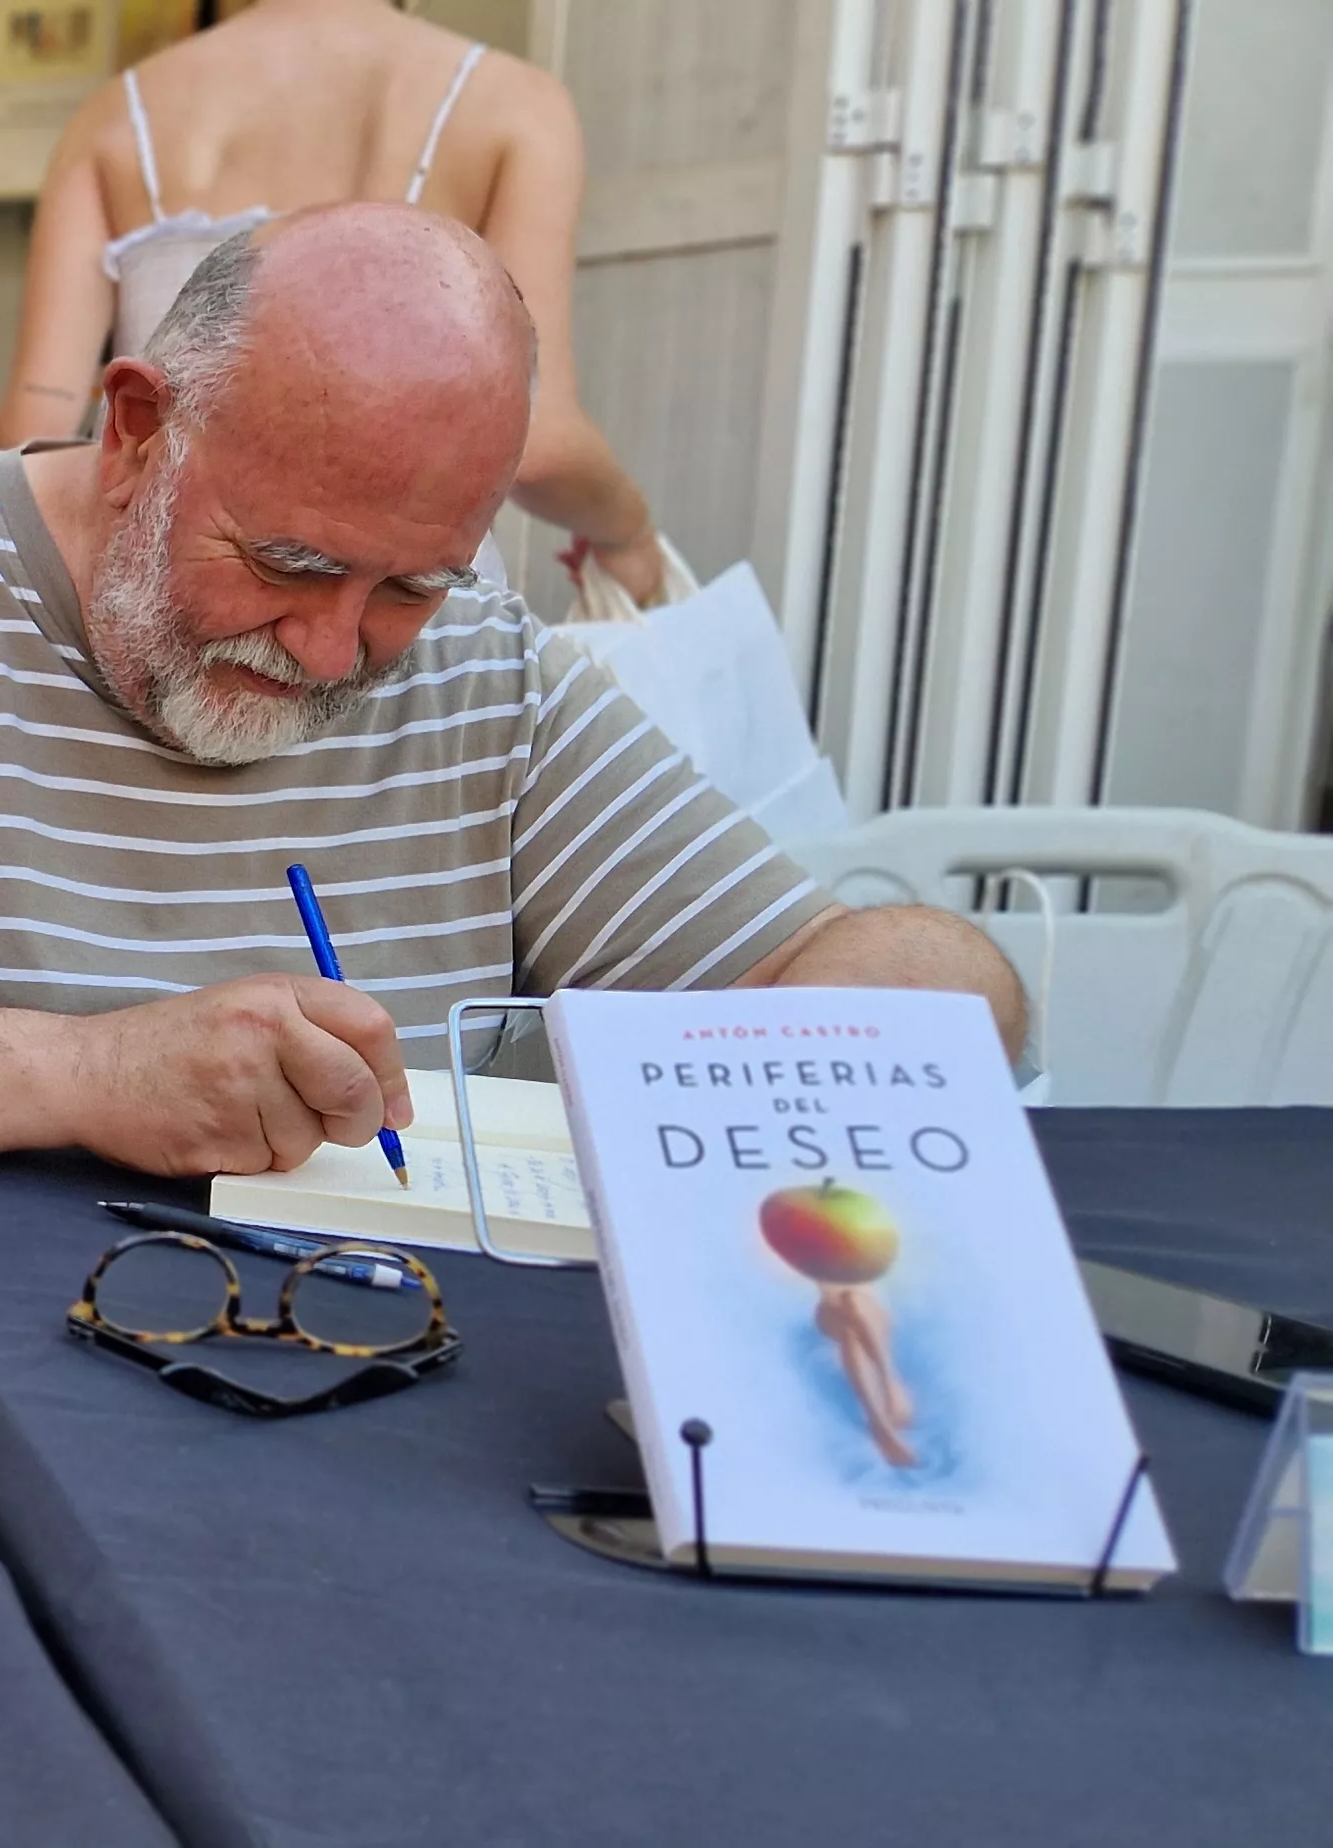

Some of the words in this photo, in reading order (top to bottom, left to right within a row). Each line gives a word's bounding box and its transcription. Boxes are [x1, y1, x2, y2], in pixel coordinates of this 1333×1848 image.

[683, 1025, 767, 1040] ANTÓN
[780, 1025, 881, 1039] CASTRO
[640, 1060, 947, 1088] PERIFERIAS
[772, 1097, 829, 1114] DEL
[657, 1124, 970, 1173] DESEO
